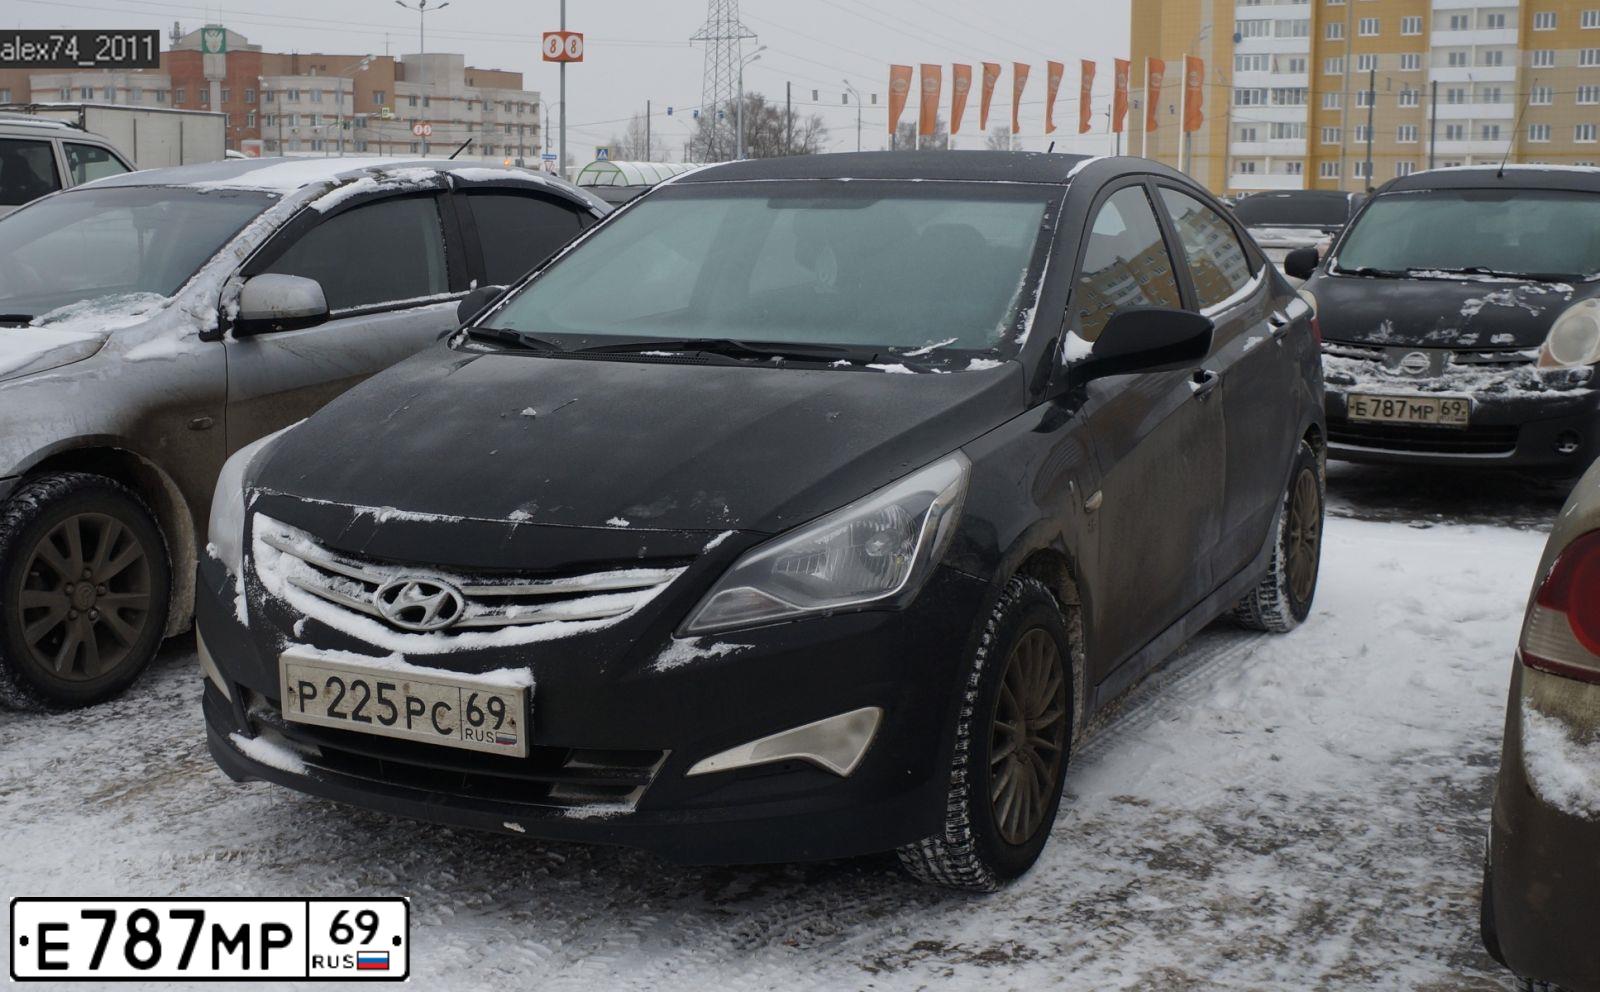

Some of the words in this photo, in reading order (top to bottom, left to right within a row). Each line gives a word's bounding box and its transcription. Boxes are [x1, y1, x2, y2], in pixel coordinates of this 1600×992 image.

[1441, 401, 1461, 416] 69
[298, 676, 453, 735] Р225РС
[466, 692, 506, 730] 69
[465, 728, 495, 744] RUS
